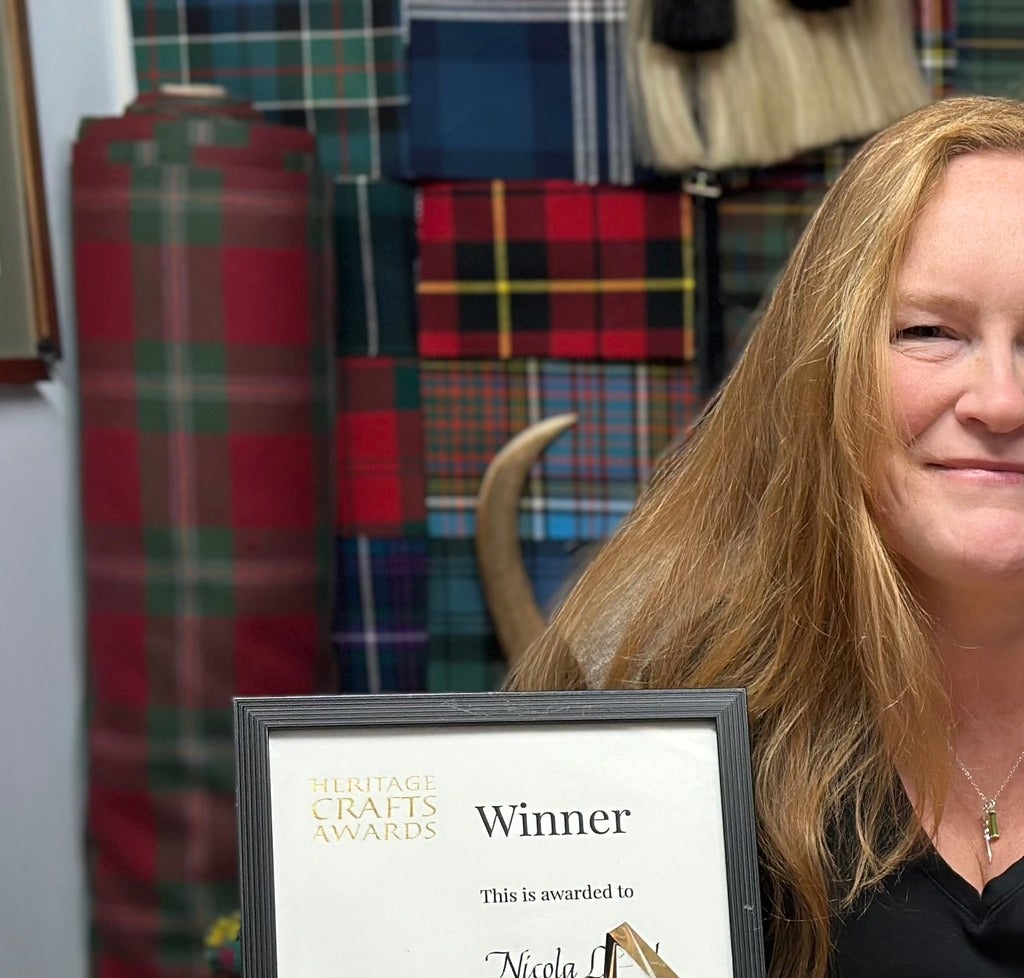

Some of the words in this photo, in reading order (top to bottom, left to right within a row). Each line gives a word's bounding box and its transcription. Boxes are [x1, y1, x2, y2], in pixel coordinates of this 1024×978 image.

[311, 775, 436, 793] HERITAGE
[312, 795, 437, 820] CRAFTS
[475, 802, 631, 838] Winner
[311, 821, 437, 843] AWARDS
[480, 888, 517, 904] This
[522, 887, 536, 902] is
[541, 884, 612, 902] awarded
[617, 885, 634, 899] to
